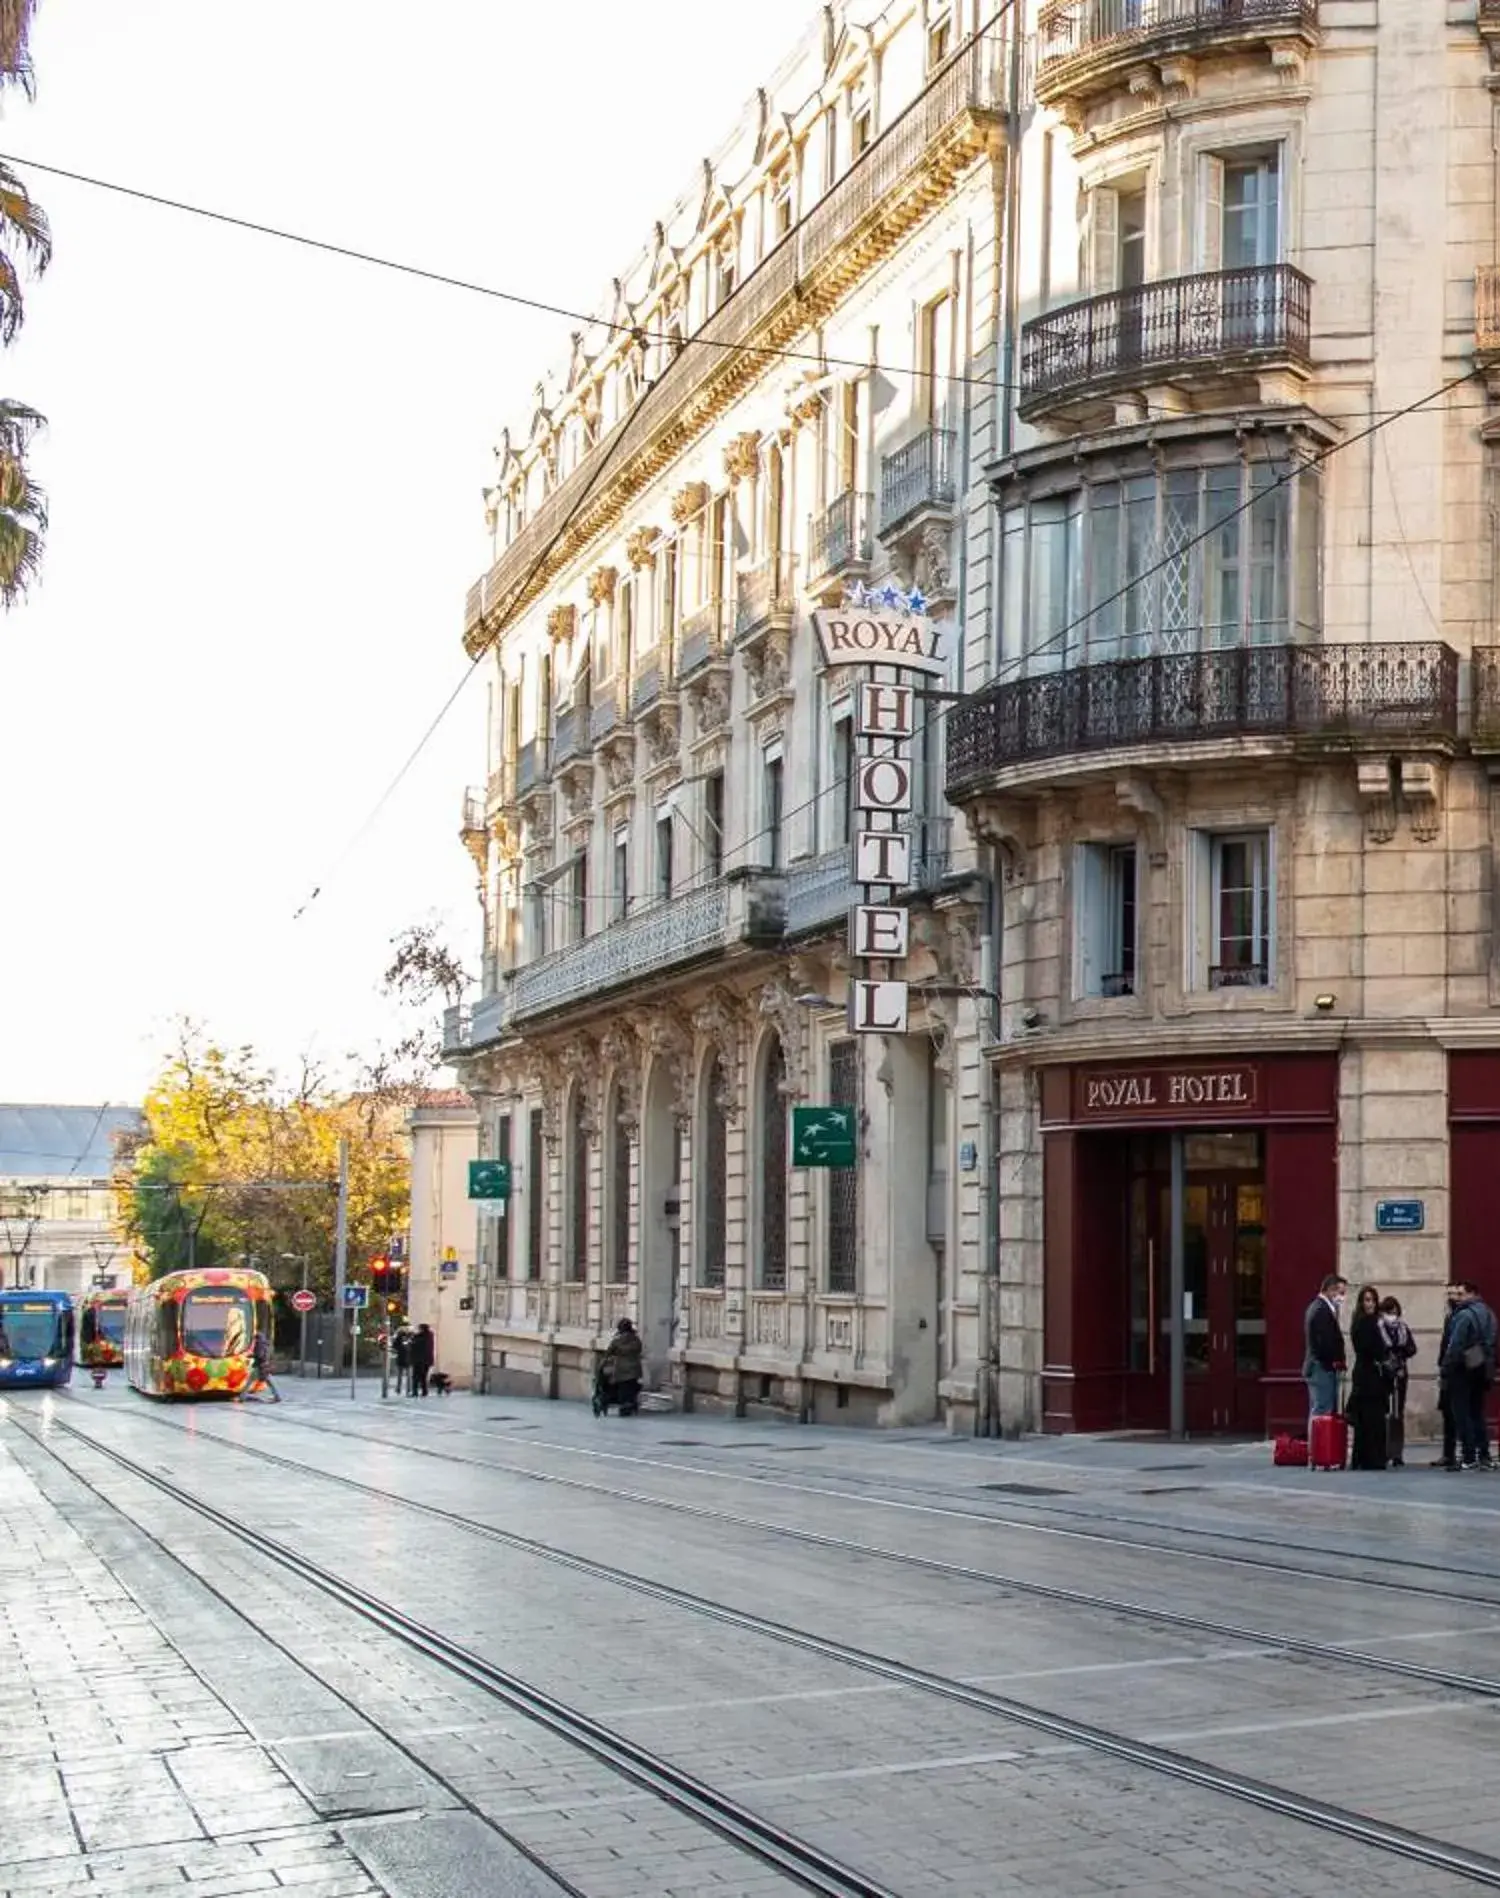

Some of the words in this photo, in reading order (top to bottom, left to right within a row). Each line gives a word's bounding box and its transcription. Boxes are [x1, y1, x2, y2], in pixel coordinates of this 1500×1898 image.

[828, 620, 948, 662] ROYAL
[859, 686, 911, 1029] HOTEL
[1087, 1077, 1157, 1107] ROYAL
[1167, 1073, 1247, 1103] HOTEL
